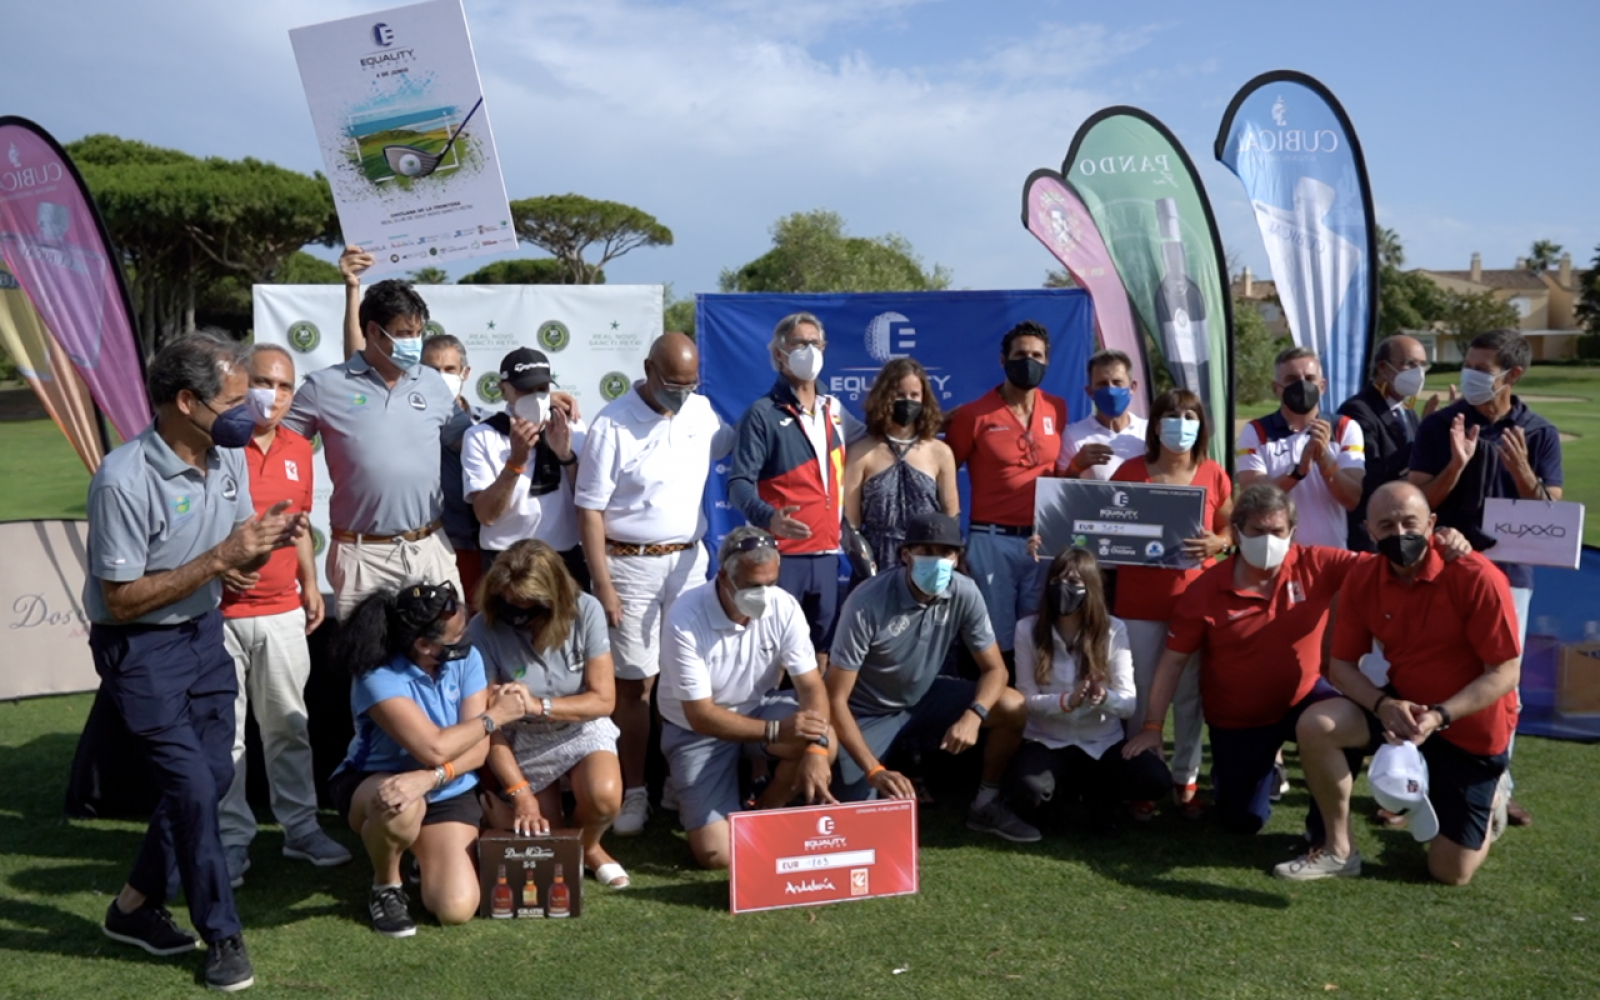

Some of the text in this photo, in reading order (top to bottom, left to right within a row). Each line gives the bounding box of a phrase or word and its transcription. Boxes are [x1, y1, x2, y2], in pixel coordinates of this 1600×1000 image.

[360, 49, 414, 67] EQUALITY
[9, 592, 73, 630] Dos
[805, 837, 846, 848] EQUALITY
[782, 860, 799, 870] EUR
